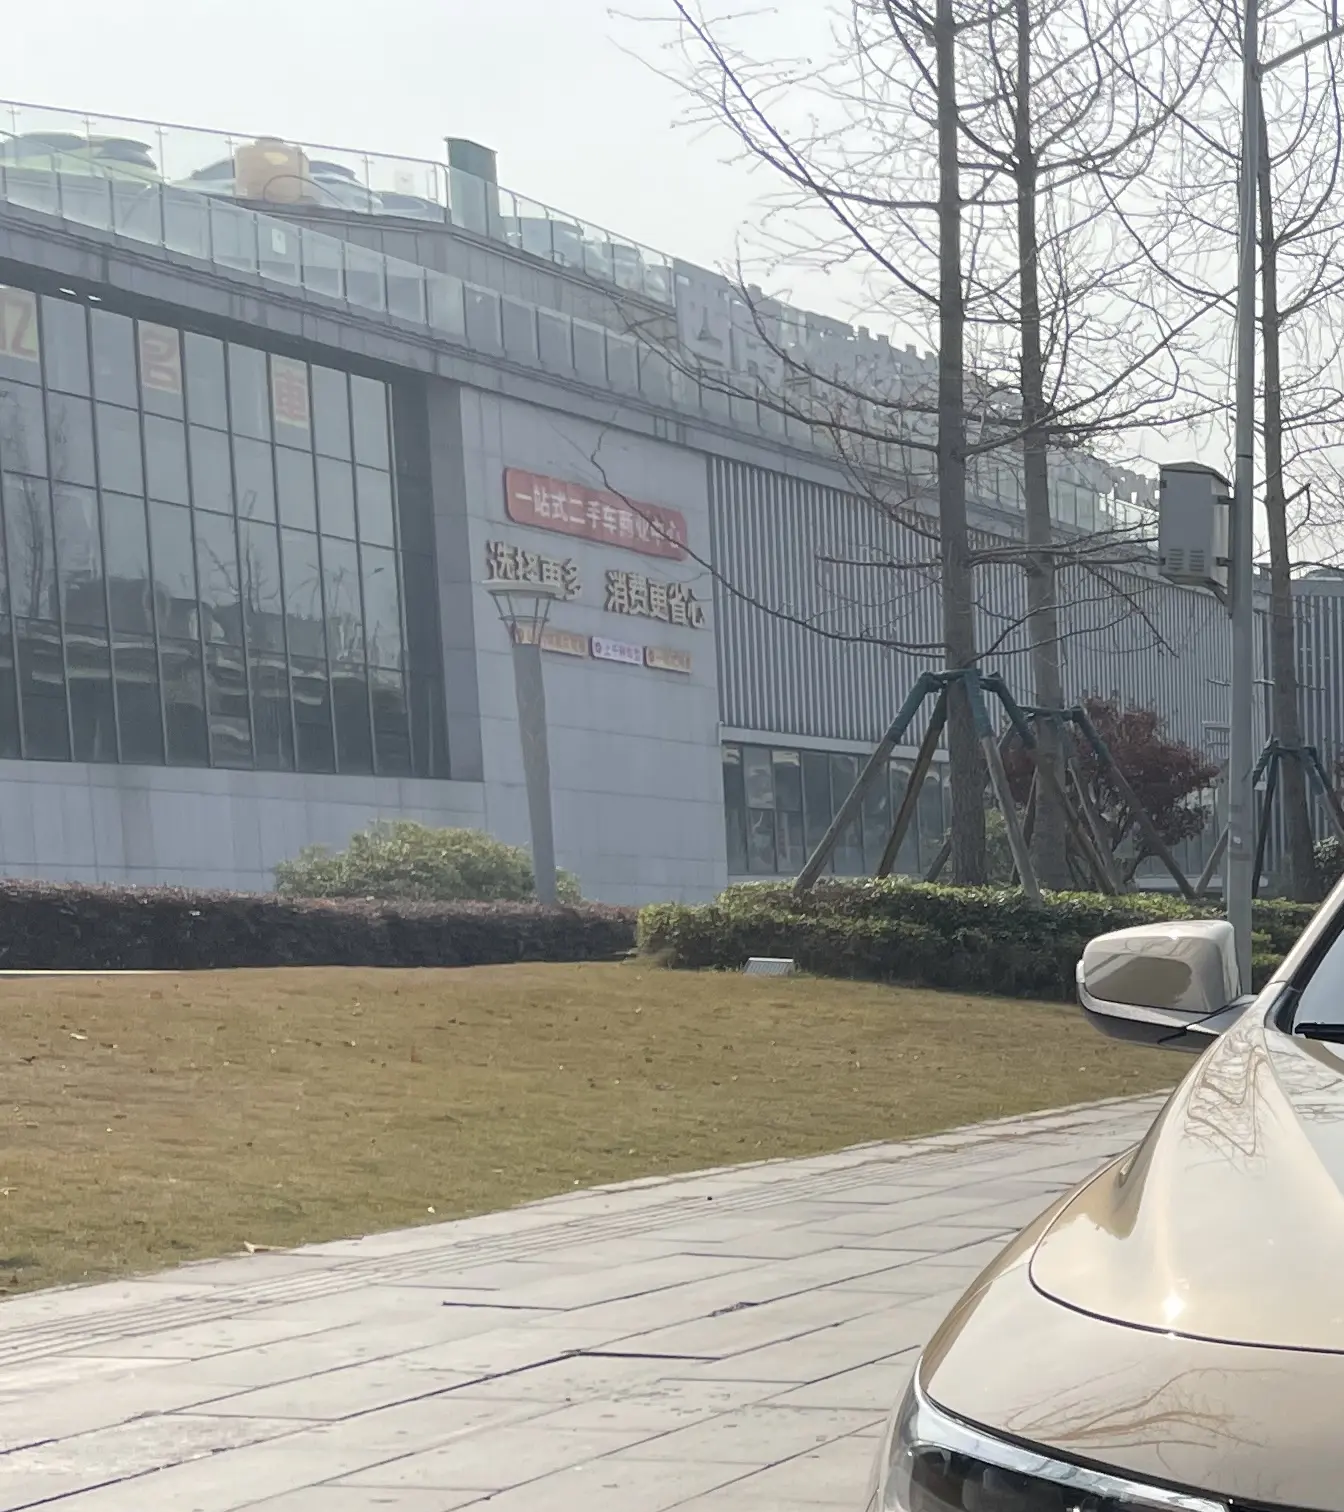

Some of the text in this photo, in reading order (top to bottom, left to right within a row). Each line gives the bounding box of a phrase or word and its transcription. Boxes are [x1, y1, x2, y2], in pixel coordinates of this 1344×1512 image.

[515, 484, 682, 549] 一站式二手车商业中心
[605, 569, 705, 629] 消费更省心
